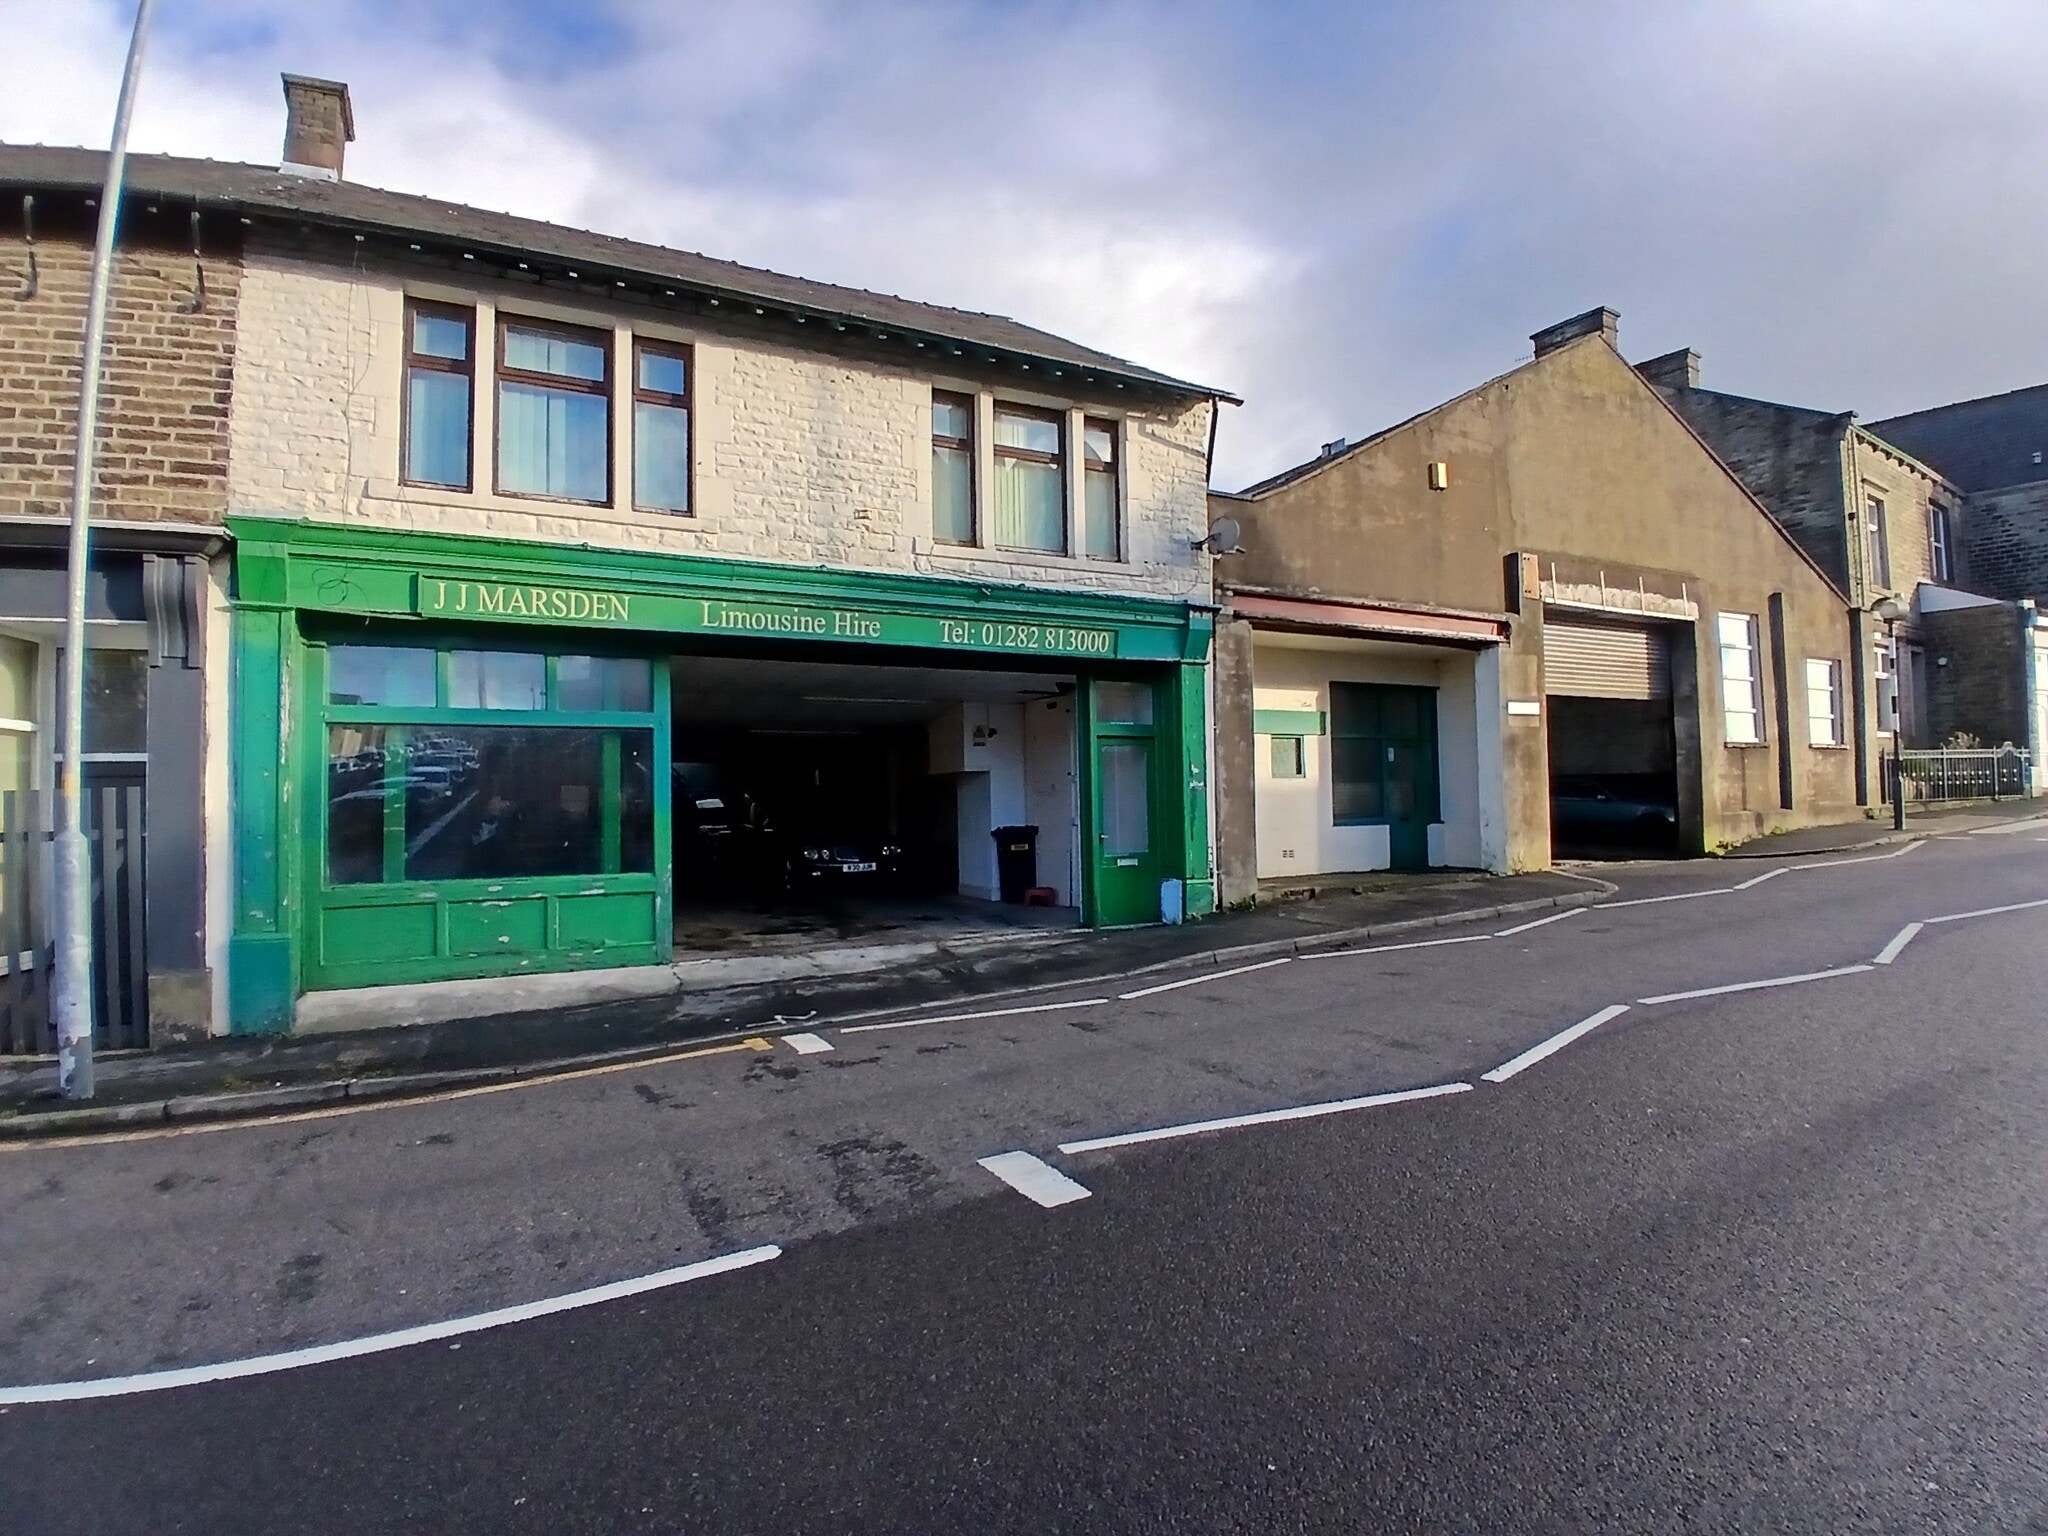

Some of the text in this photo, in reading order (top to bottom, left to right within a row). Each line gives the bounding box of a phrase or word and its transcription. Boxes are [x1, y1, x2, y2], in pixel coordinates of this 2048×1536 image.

[434, 582, 631, 621] J J MARSDEN
[702, 601, 881, 637] Limousine Hire
[940, 620, 1110, 653] Tel: 01282 813000
